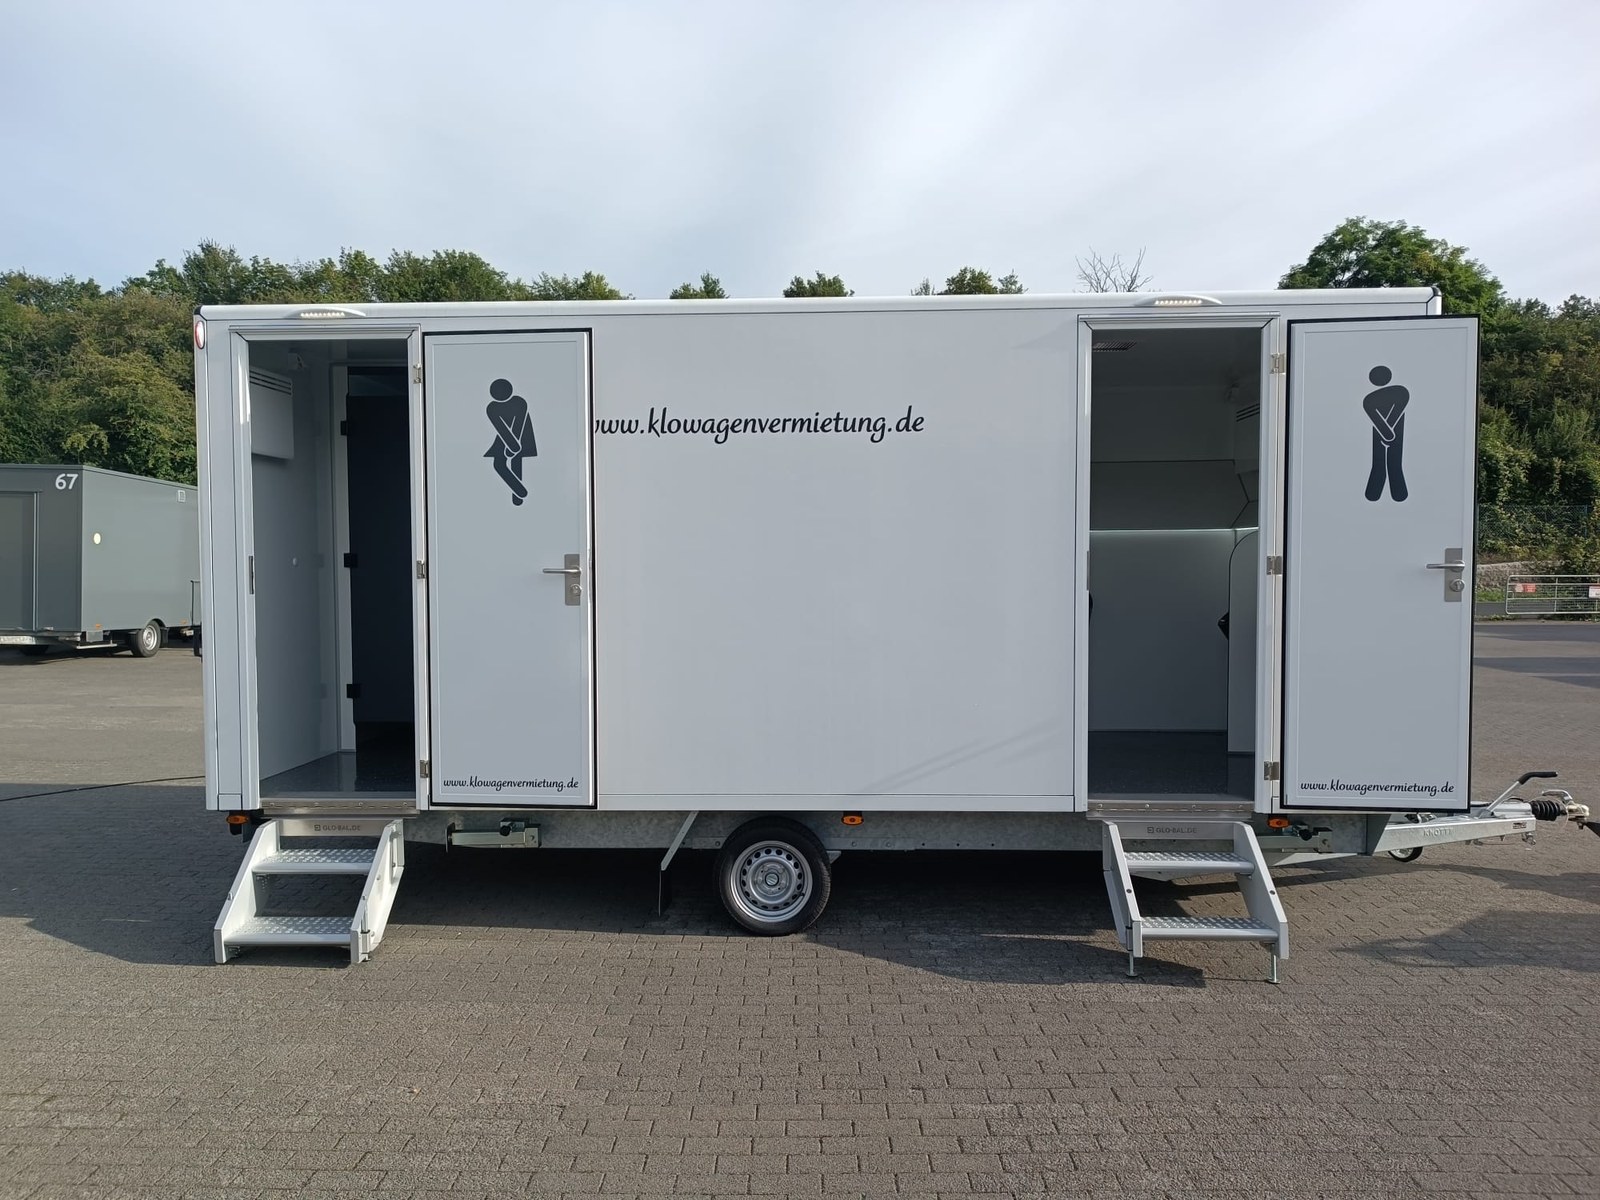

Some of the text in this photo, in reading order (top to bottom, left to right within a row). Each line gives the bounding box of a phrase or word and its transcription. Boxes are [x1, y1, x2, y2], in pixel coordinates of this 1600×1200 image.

[595, 404, 925, 445] ww.klowagenvermietung.de
[55, 473, 79, 490] 67
[443, 776, 580, 793] www.klowagenvermietung.de
[1300, 778, 1456, 796] www.klowagenvermietung.de
